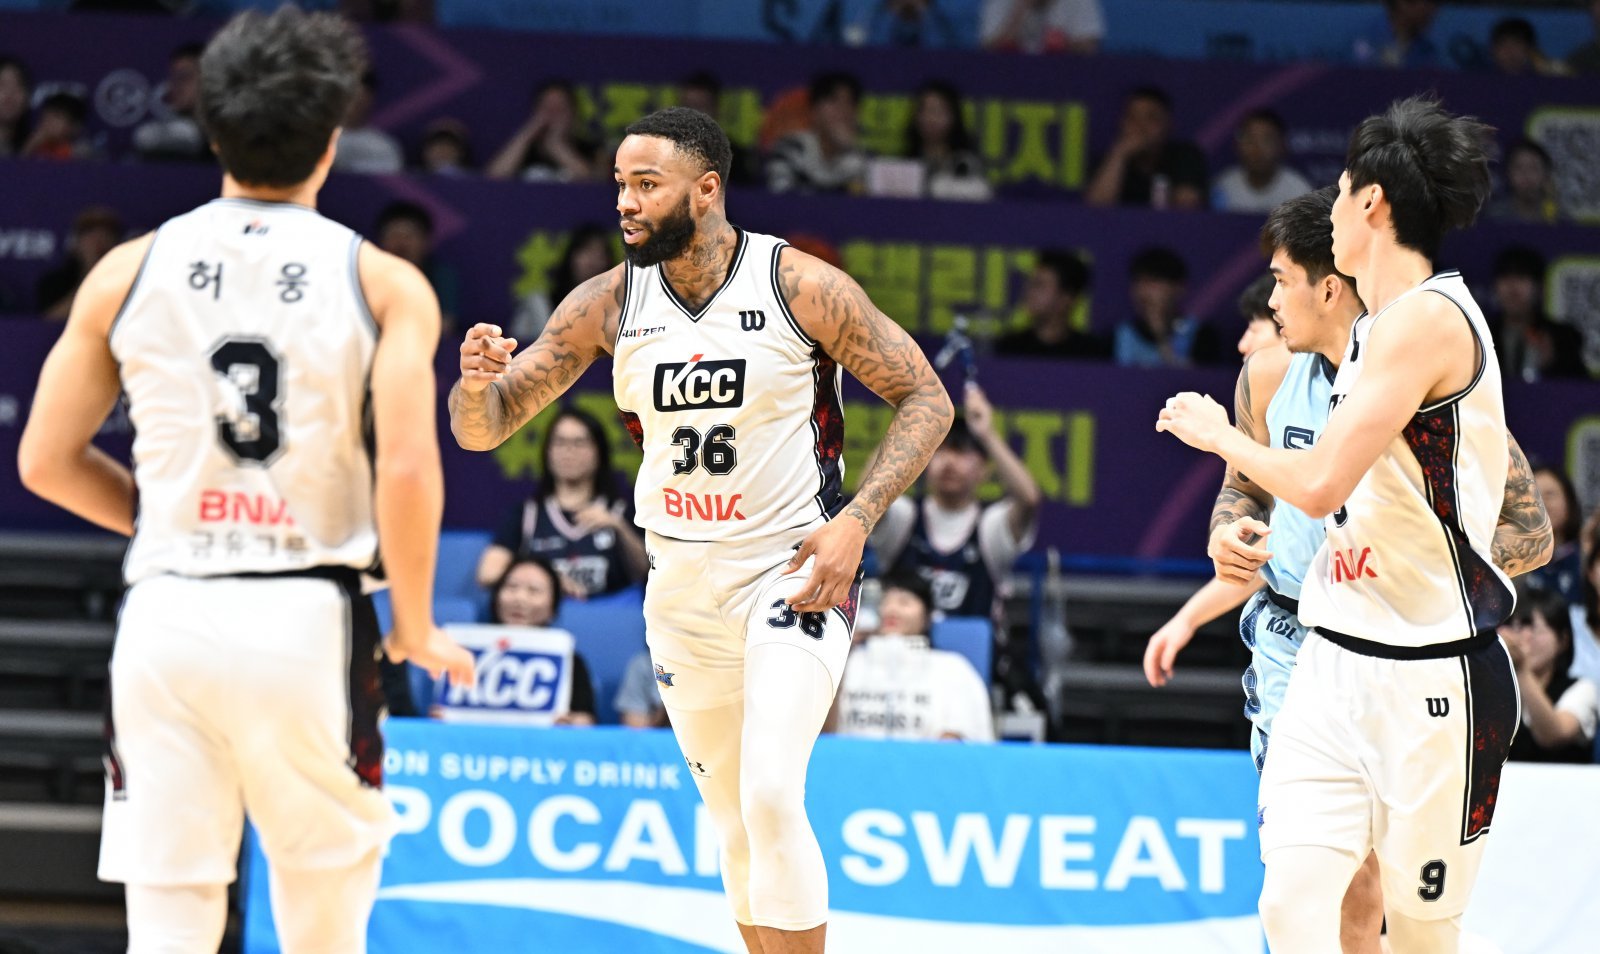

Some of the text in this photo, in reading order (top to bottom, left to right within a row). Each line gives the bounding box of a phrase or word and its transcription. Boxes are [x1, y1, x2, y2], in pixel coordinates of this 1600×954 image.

[188, 260, 309, 303] 허 웅
[207, 334, 286, 468] 3
[661, 360, 737, 407] KCC
[670, 424, 737, 476] 36
[663, 488, 746, 521] BNK
[1330, 547, 1378, 584] NK
[1266, 615, 1297, 640] KBL
[440, 752, 567, 785] SUPPLY
[574, 760, 681, 790] DRINK
[840, 808, 1247, 894] SWEAT
[1417, 859, 1447, 902] 9
